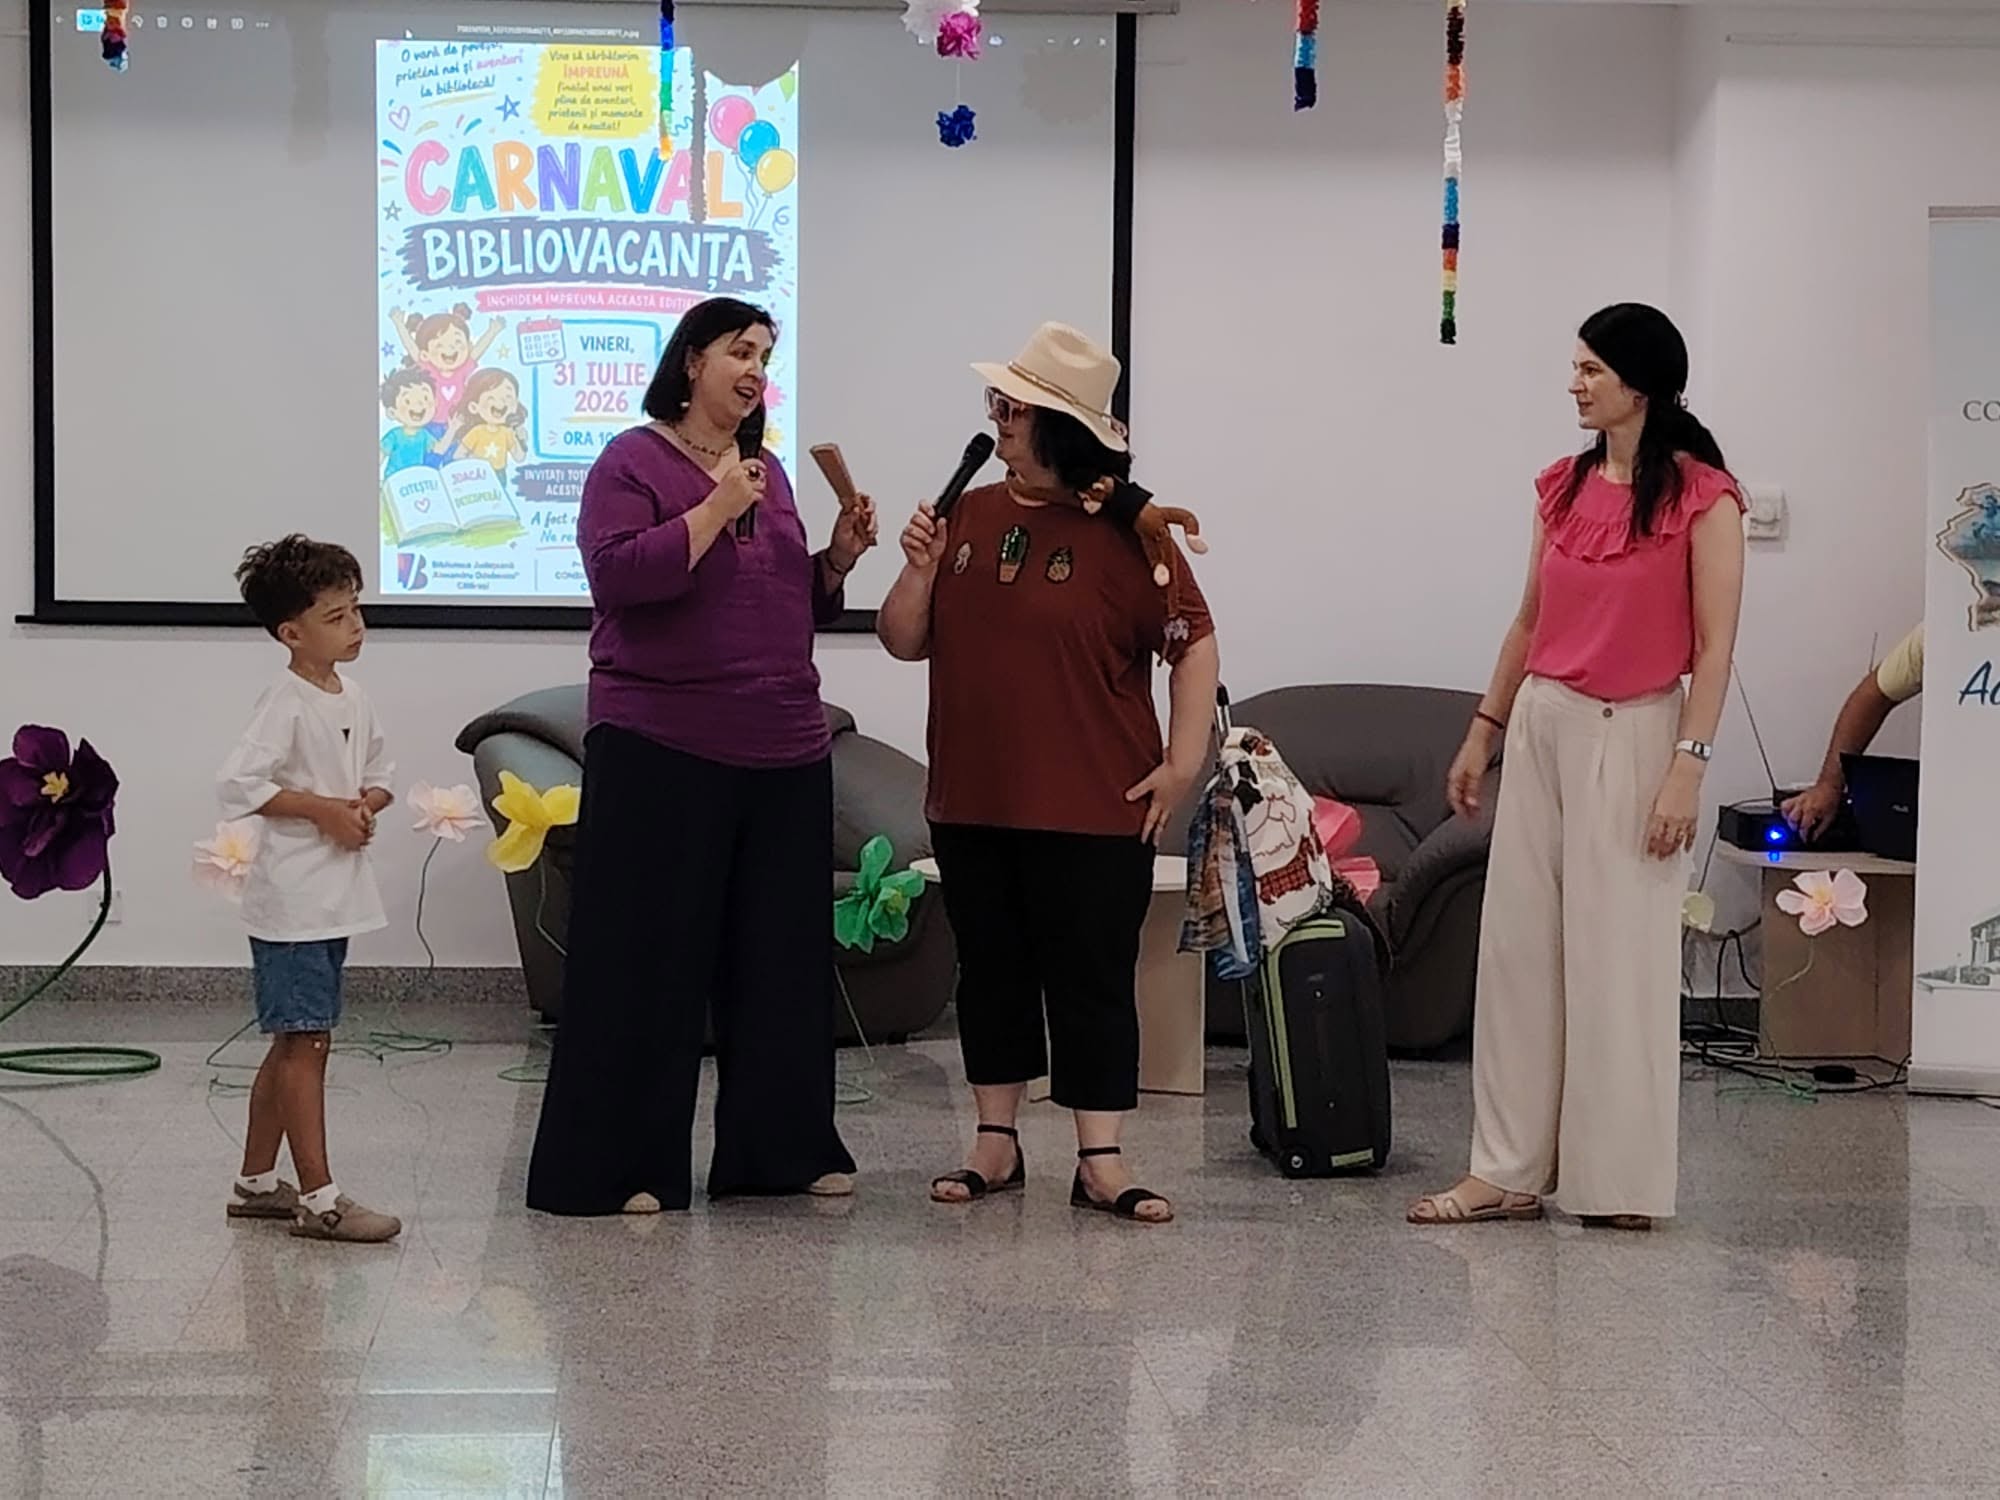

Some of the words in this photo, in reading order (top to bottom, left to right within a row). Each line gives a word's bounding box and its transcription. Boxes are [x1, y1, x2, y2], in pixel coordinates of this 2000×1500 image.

[401, 48, 411, 63] O
[404, 140, 744, 218] CARNAVAL
[422, 224, 755, 291] BIBLIOVACANȚA
[580, 335, 635, 354] VINERI,
[553, 361, 576, 386] 31
[586, 361, 647, 386] IULIE
[574, 390, 629, 413] 2026
[563, 431, 594, 445] ORA
[530, 511, 541, 525] A
[540, 529, 556, 543] Ne
